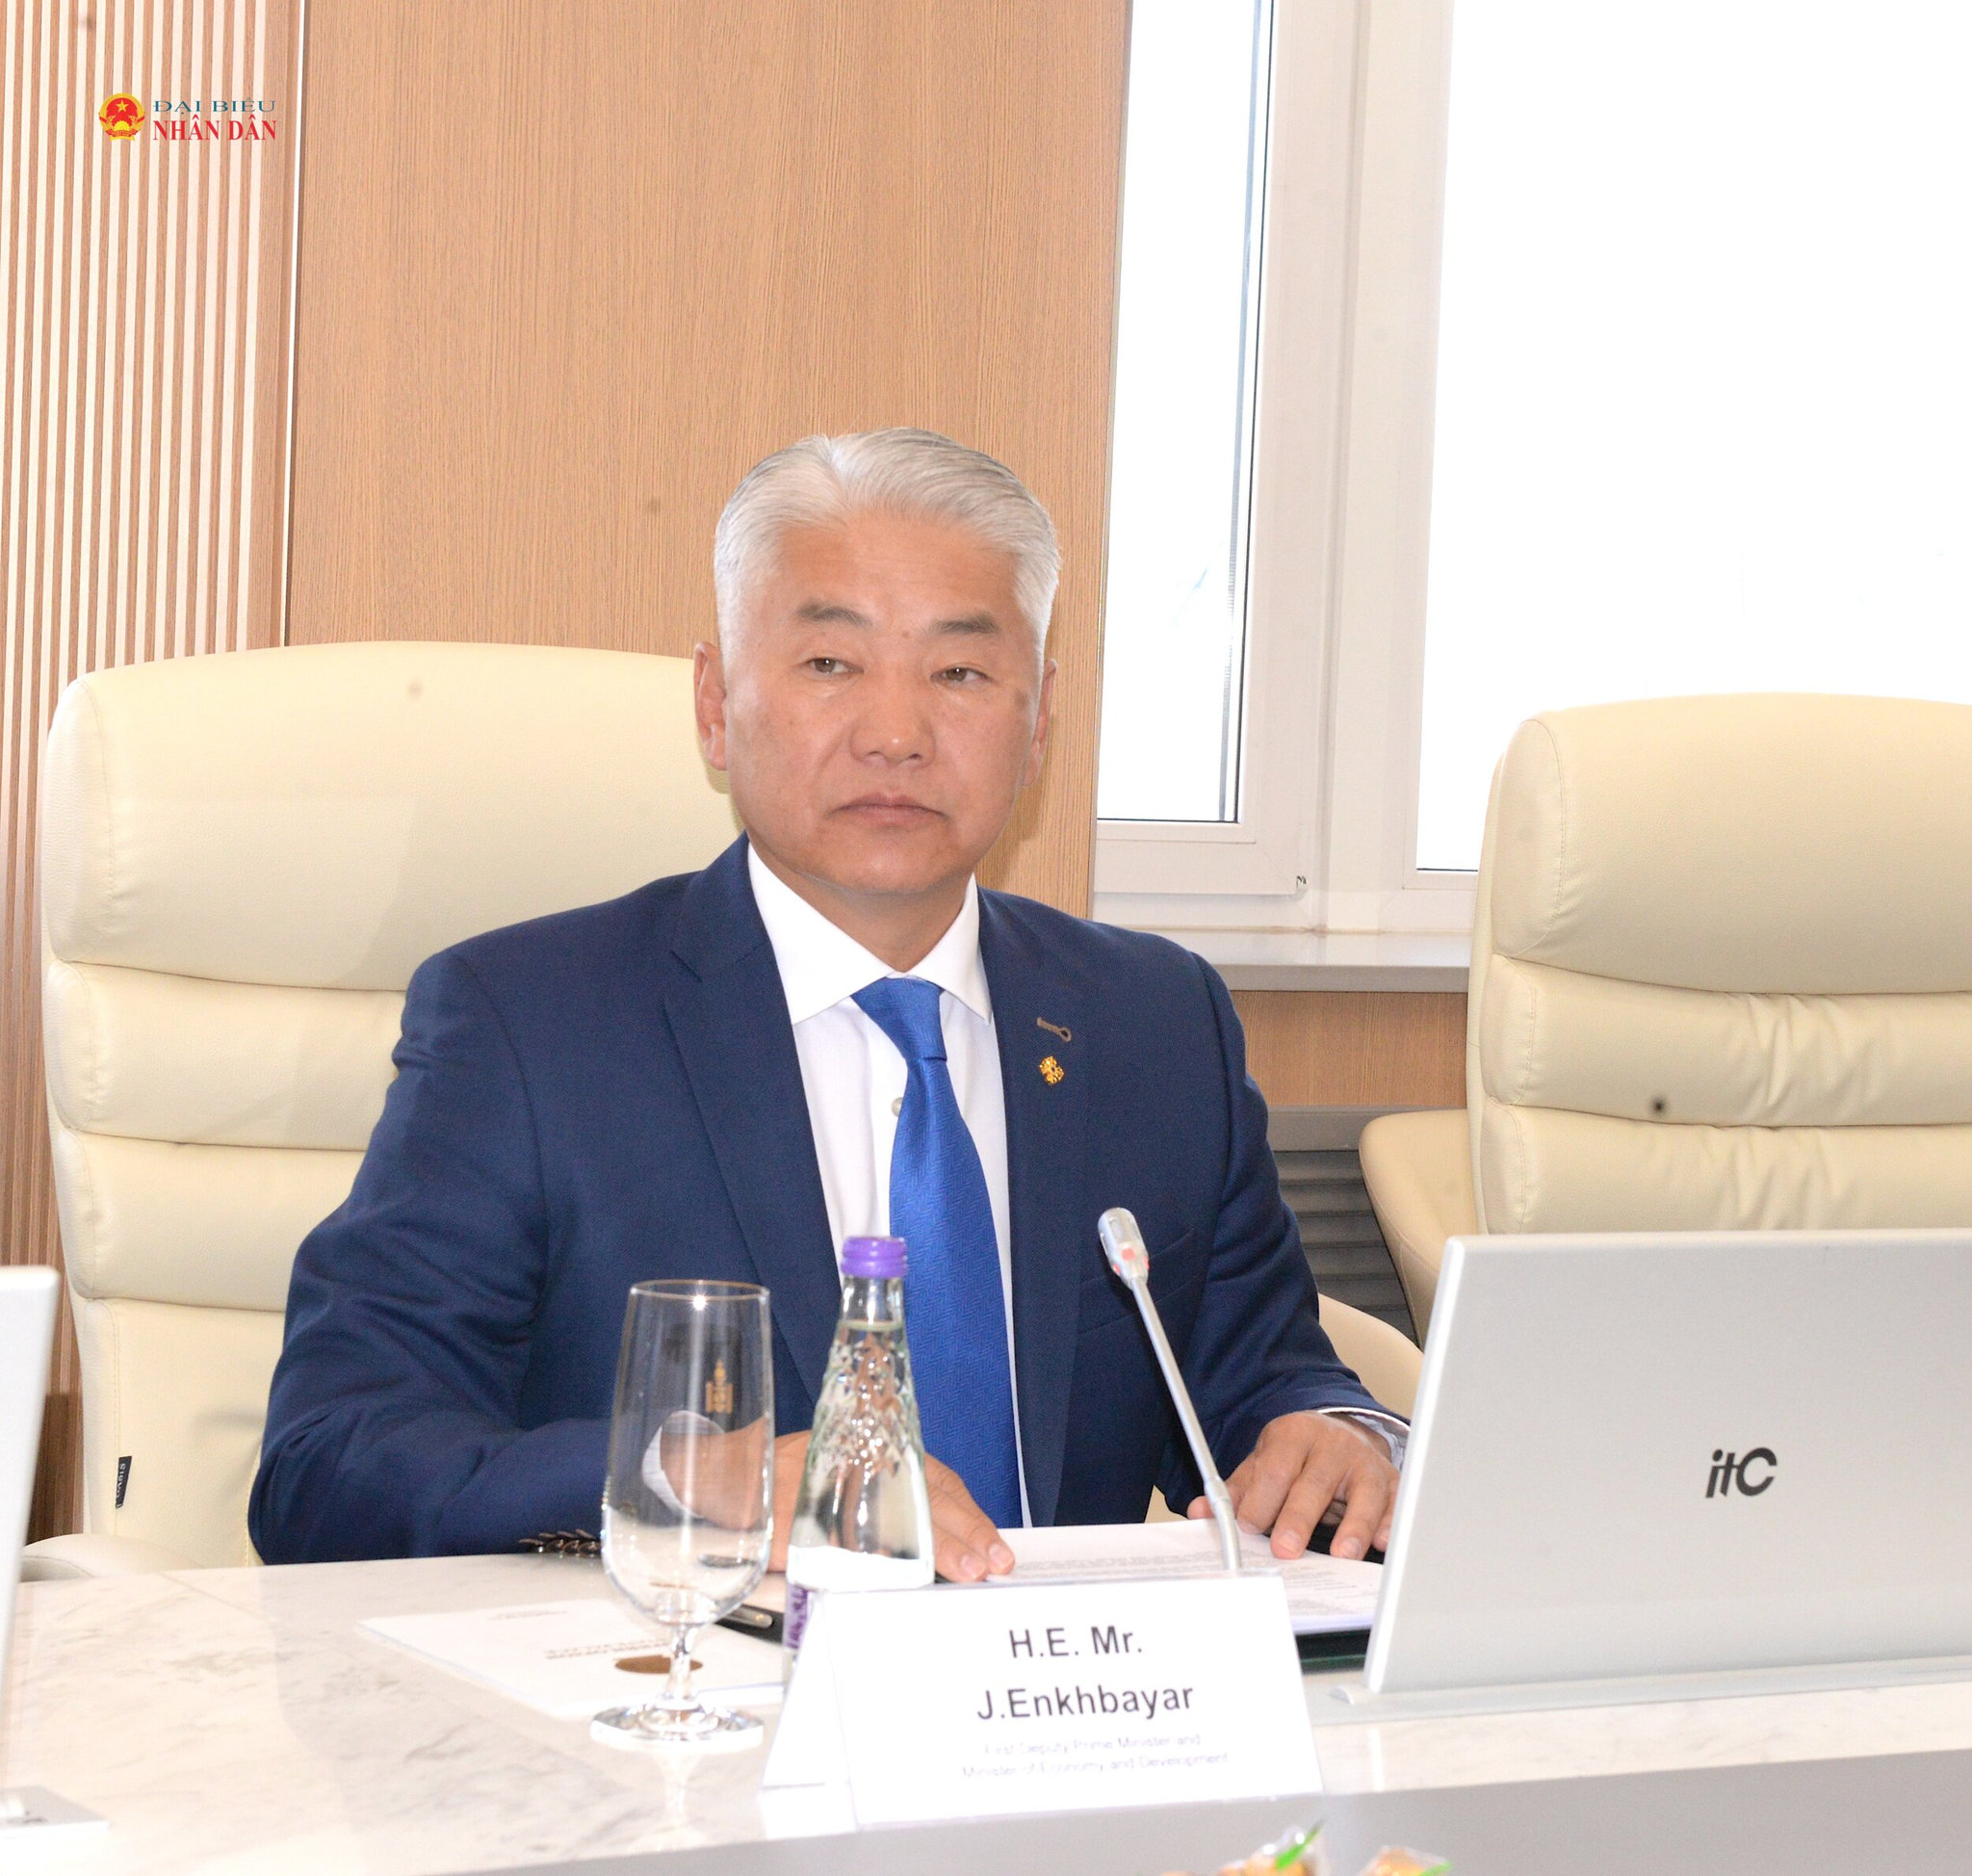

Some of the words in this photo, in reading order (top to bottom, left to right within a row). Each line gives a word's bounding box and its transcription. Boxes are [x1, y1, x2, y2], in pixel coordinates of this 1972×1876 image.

[1009, 1627, 1080, 1658] H.E.
[1090, 1625, 1143, 1655] Mr.
[976, 1684, 1194, 1720] J.Enkhbayar
[984, 1742, 1017, 1756] Frst
[1117, 1735, 1170, 1750] Minister
[1177, 1733, 1202, 1746] and
[1110, 1757, 1134, 1770] and
